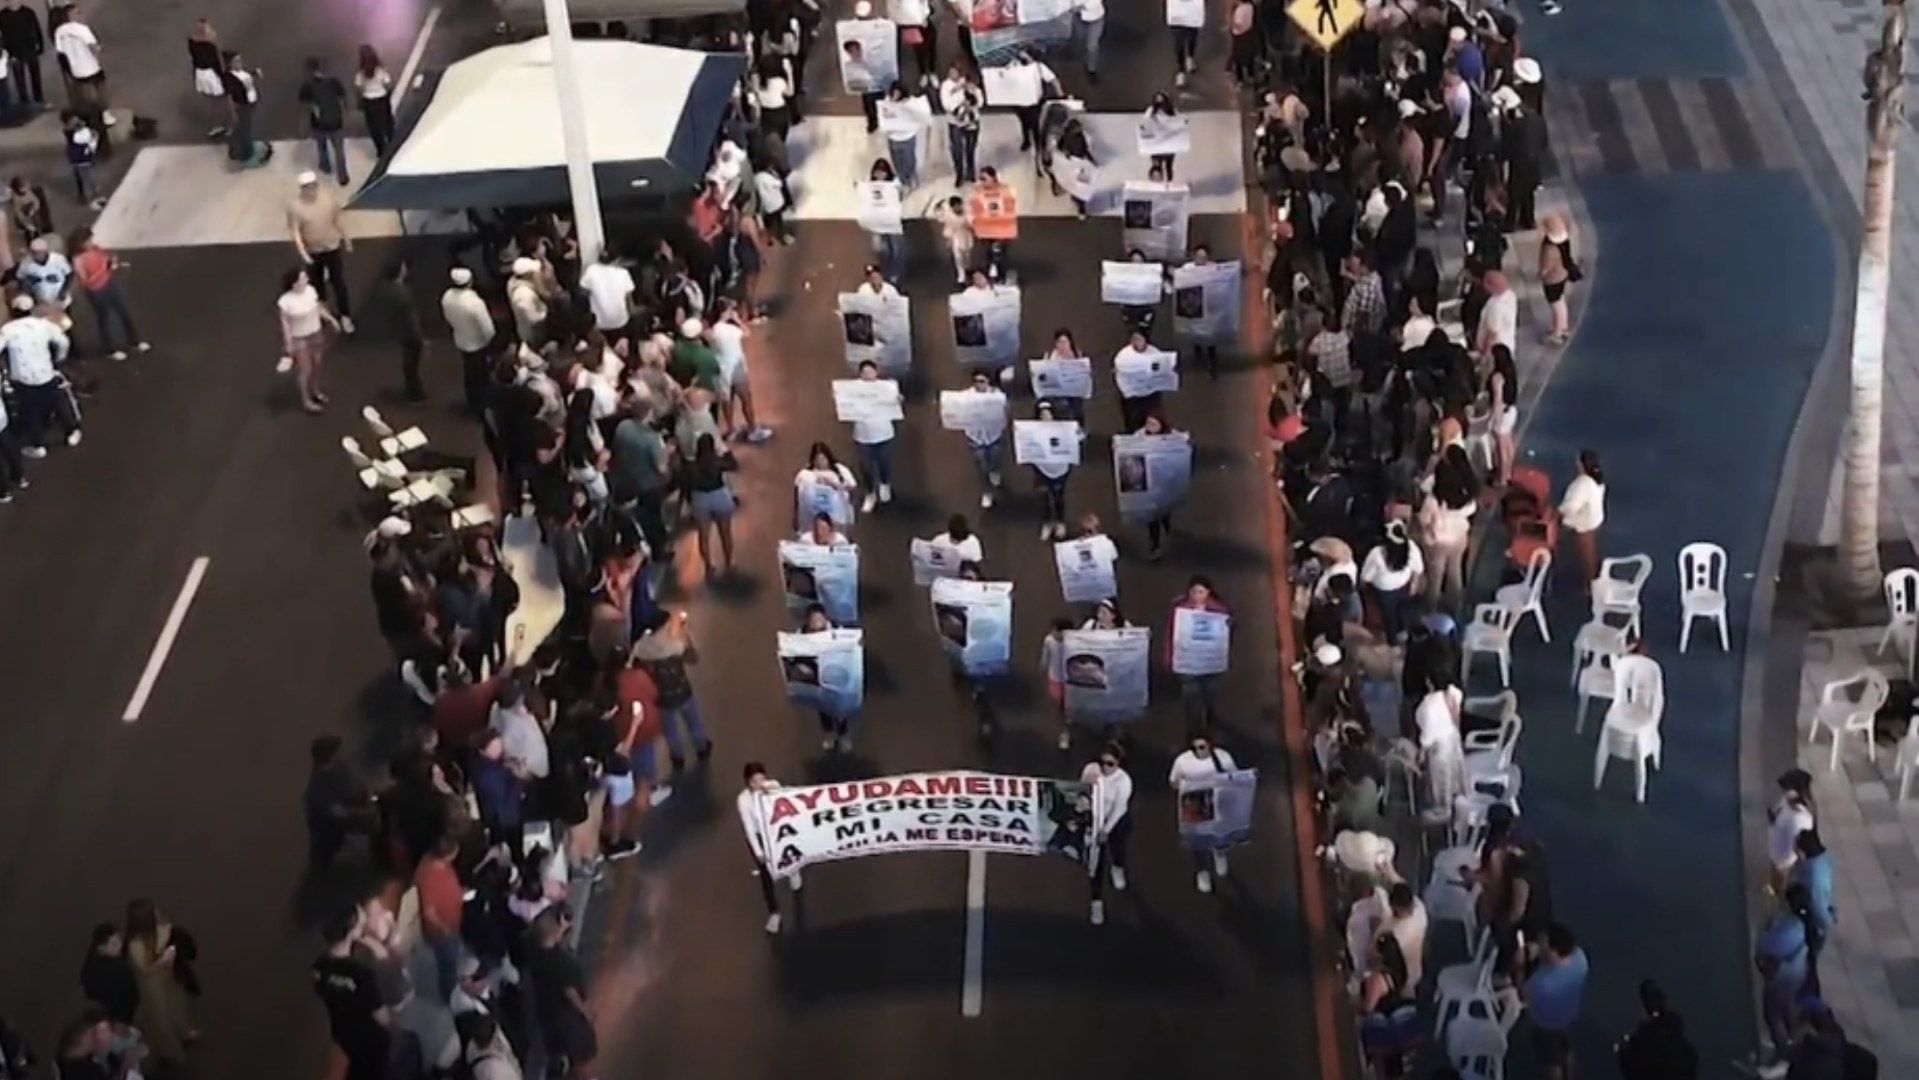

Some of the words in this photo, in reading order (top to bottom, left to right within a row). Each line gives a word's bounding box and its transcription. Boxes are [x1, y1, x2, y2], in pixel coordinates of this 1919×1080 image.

[770, 777, 1031, 825] AYUDAME!!!
[812, 797, 1030, 827] REGRESAR
[836, 818, 880, 840] MI
[918, 812, 1030, 832] CASA
[906, 828, 938, 840] ME
